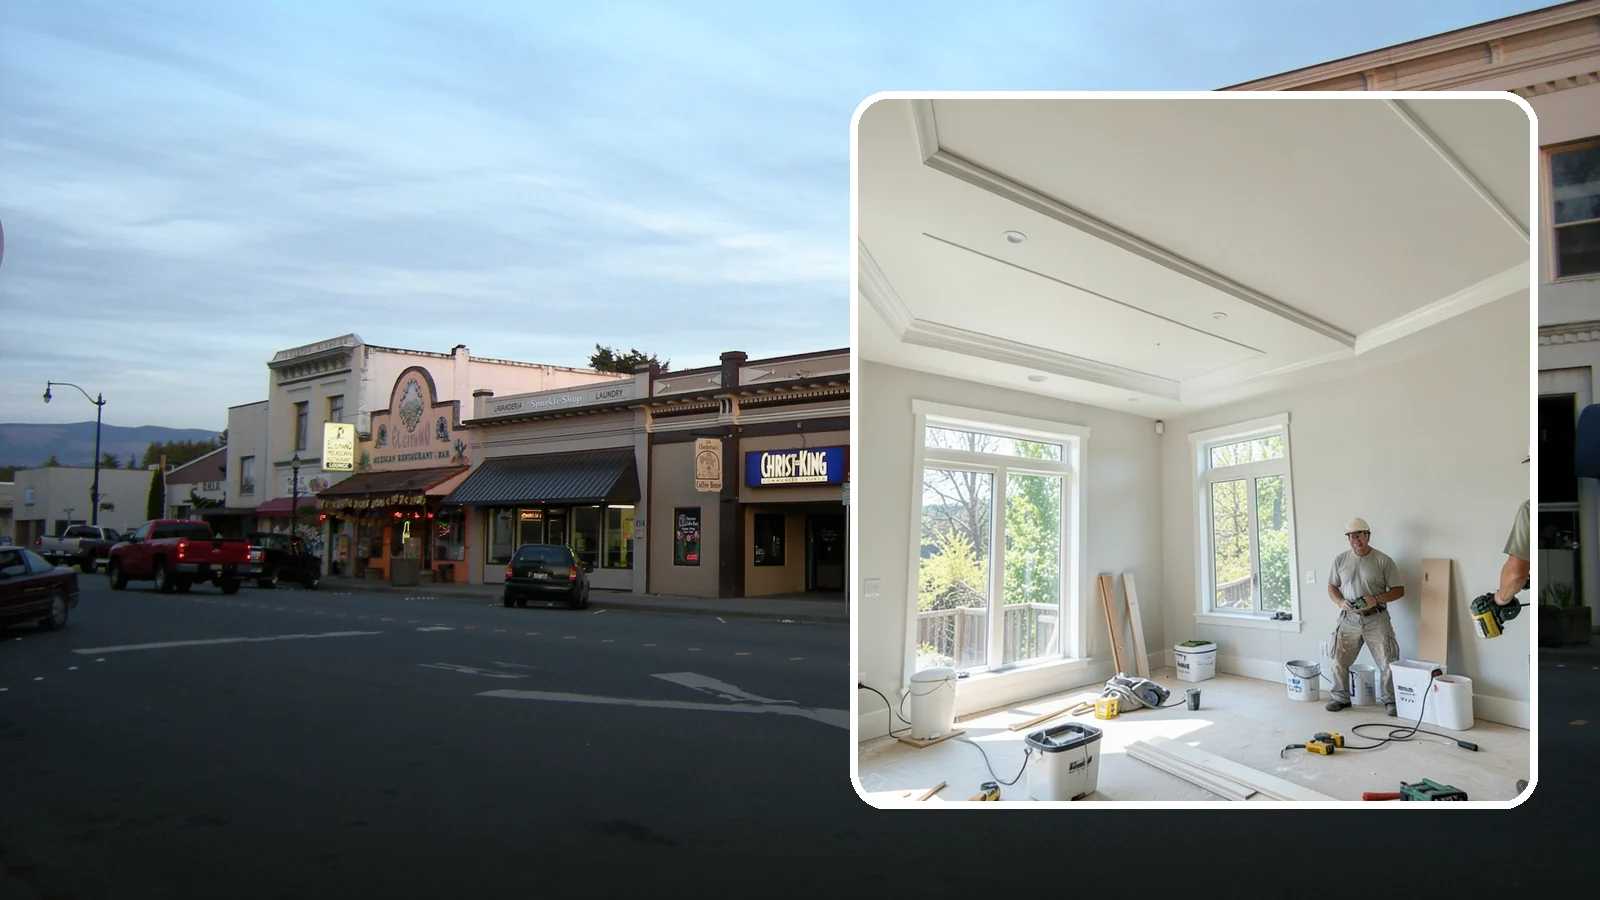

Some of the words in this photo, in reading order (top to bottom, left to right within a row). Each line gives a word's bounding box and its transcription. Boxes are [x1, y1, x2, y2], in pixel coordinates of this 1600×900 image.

[595, 389, 624, 400] LAUNDRY
[562, 395, 583, 406] Shop
[493, 402, 523, 413] LAVANDERIA
[373, 454, 396, 464] MEXICAN
[397, 451, 434, 462] RESTAURANT
[438, 450, 450, 459] BAR
